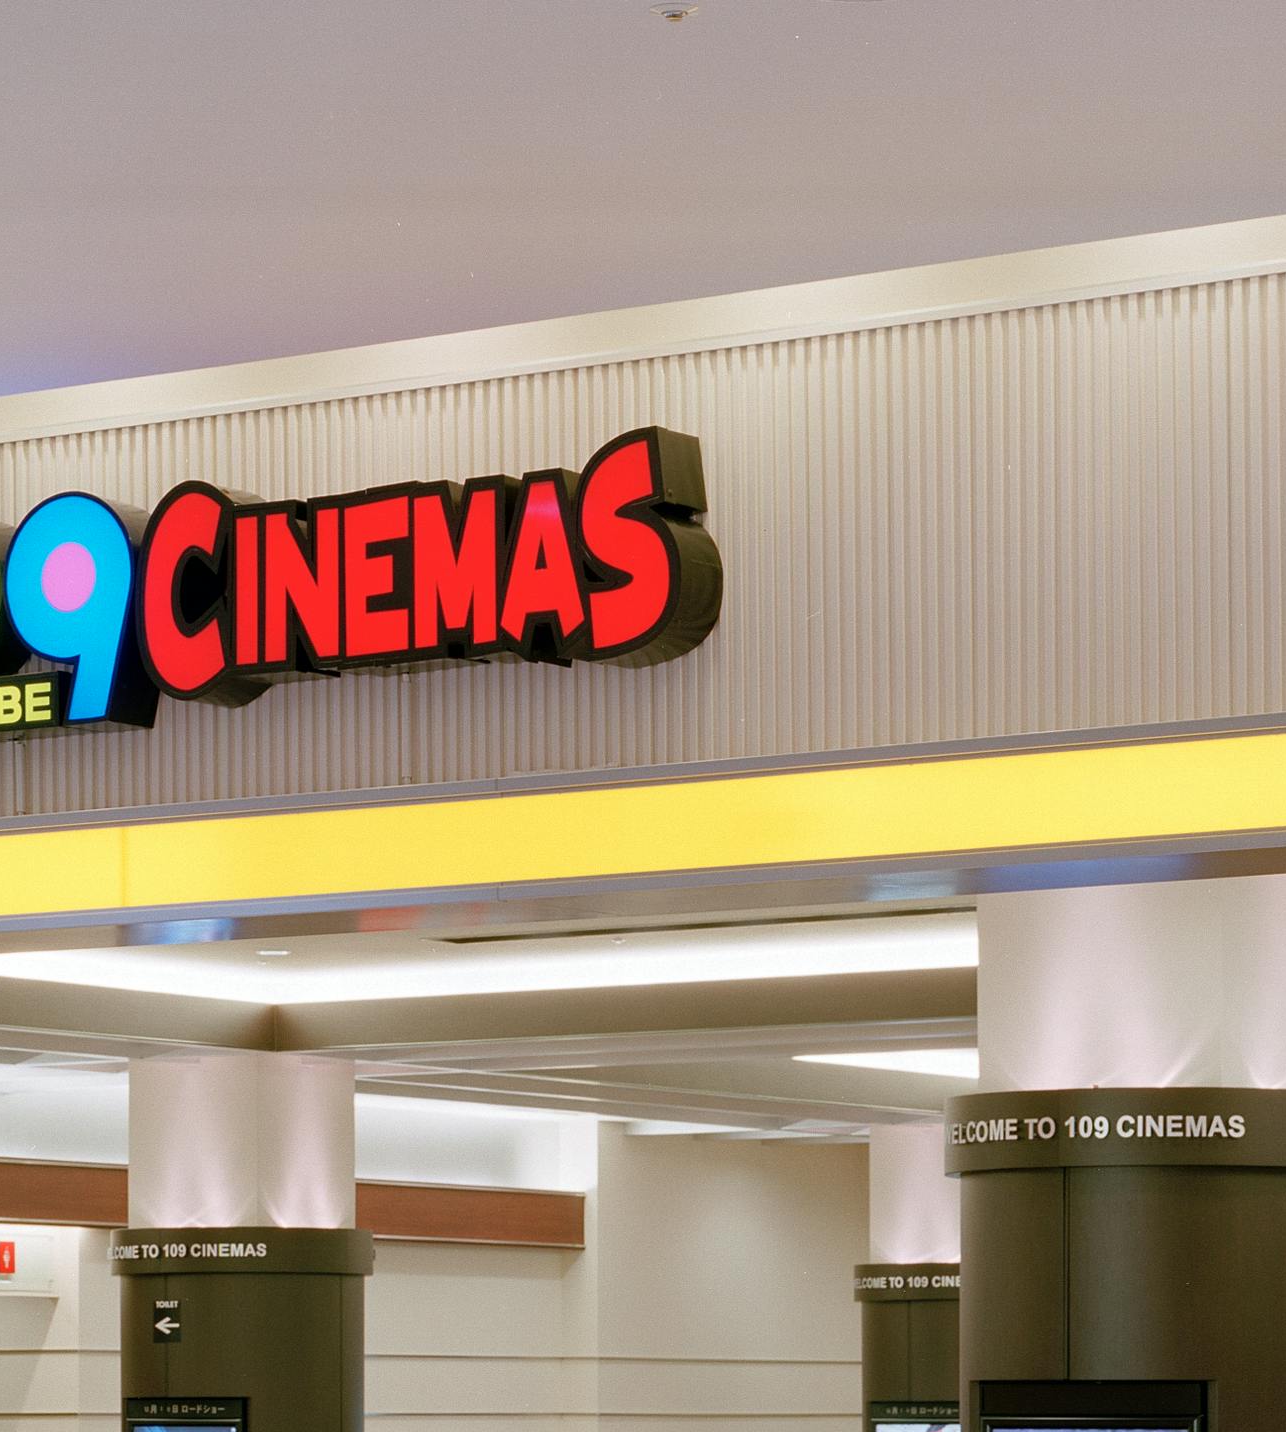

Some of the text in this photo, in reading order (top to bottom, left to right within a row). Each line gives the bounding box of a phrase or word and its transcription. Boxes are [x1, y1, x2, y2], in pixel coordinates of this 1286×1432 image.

[143, 439, 670, 692] CINEMAS
[1024, 1116, 1056, 1140] TO
[1064, 1115, 1109, 1139] 109
[1116, 1114, 1246, 1138] CINEMAS
[142, 1244, 160, 1258] TO
[163, 1243, 187, 1258] 109
[190, 1243, 267, 1258] CINEMAS
[888, 1276, 904, 1289] TO
[907, 1276, 929, 1288] 109
